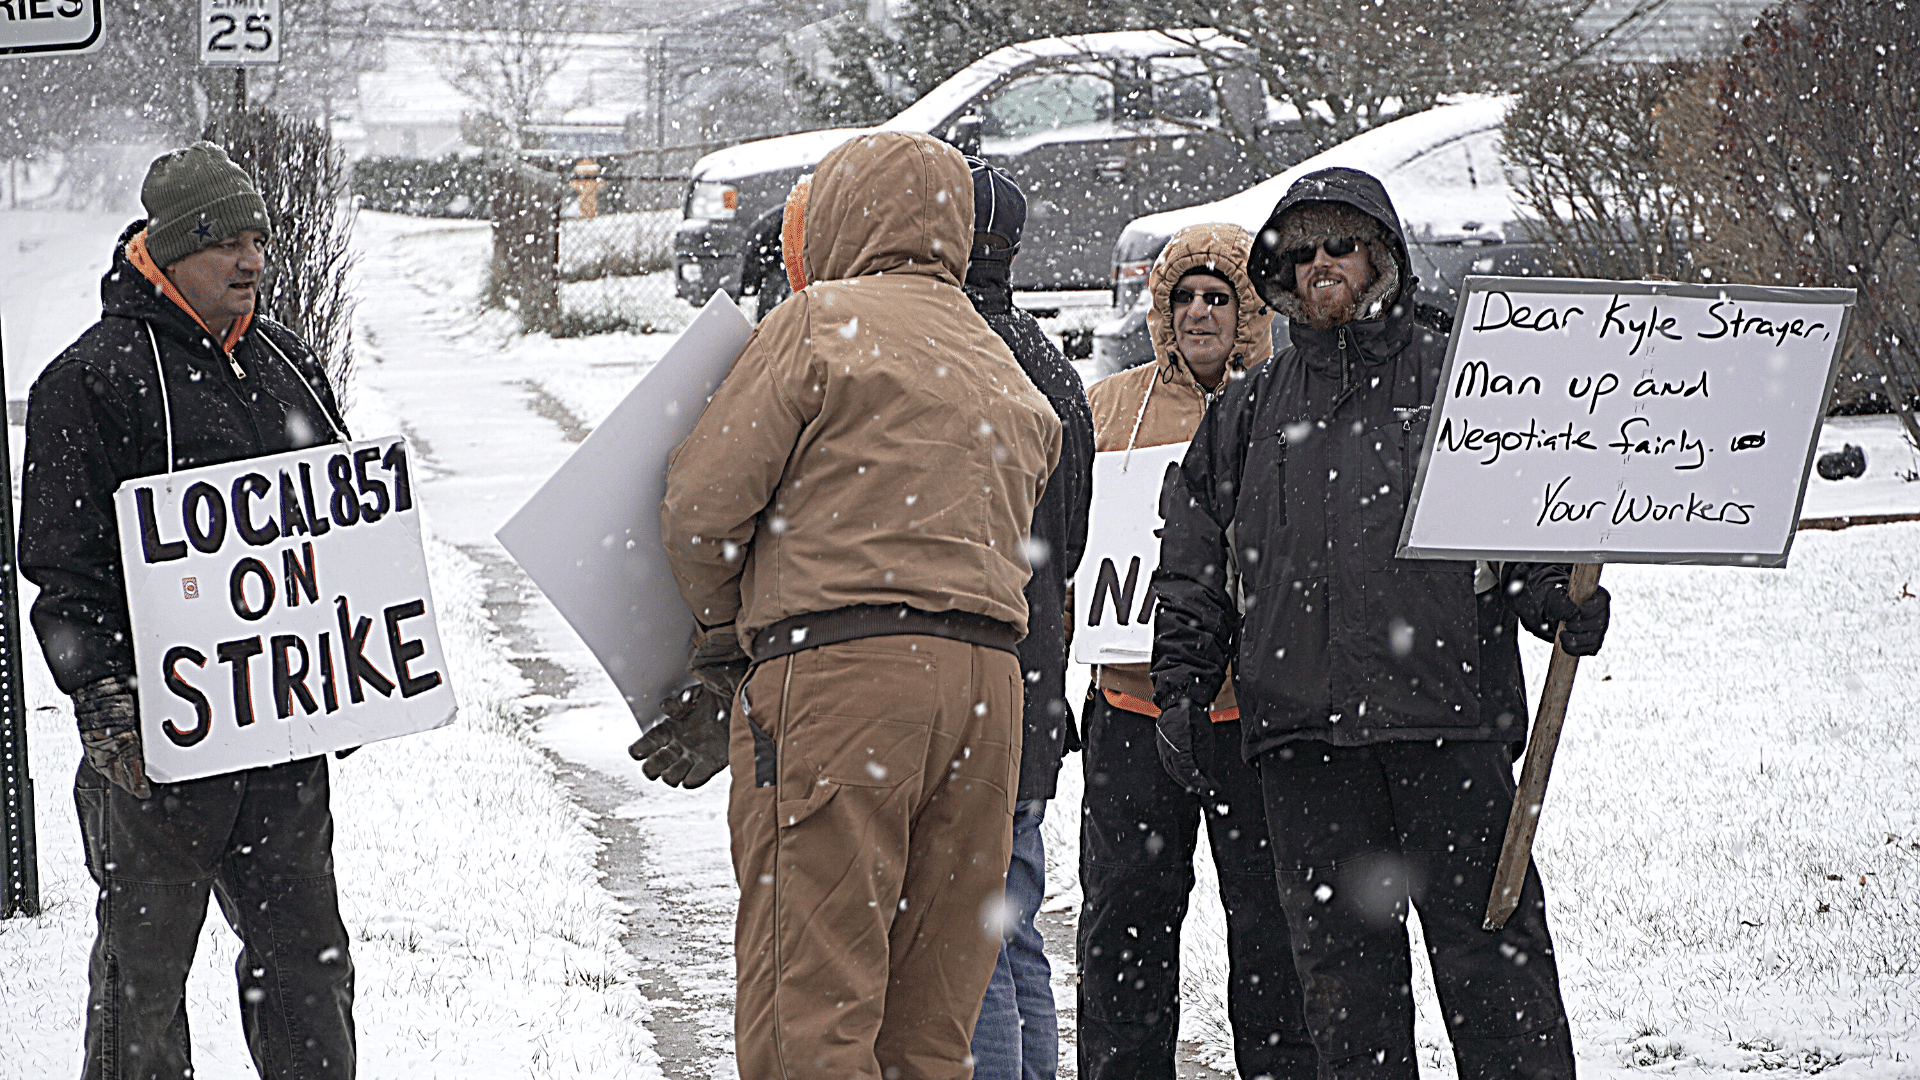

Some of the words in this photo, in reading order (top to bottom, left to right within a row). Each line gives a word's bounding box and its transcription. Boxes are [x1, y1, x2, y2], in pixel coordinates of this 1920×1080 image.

[208, 14, 272, 51] 25
[1473, 291, 1584, 333] Dear
[1599, 294, 1682, 356] Kyle
[1697, 301, 1832, 347] Strayer,
[1455, 360, 1541, 398] Man
[1569, 372, 1618, 414] up
[1634, 370, 1709, 398] and
[1437, 417, 1597, 465] Negotiate
[1608, 417, 1714, 470] fairly.
[134, 462, 331, 564] LOCAL
[327, 441, 412, 528] 851
[1536, 476, 1606, 527] Your
[1611, 489, 1755, 525] Workers
[229, 541, 319, 621] ON
[162, 594, 442, 748] STRIKE
